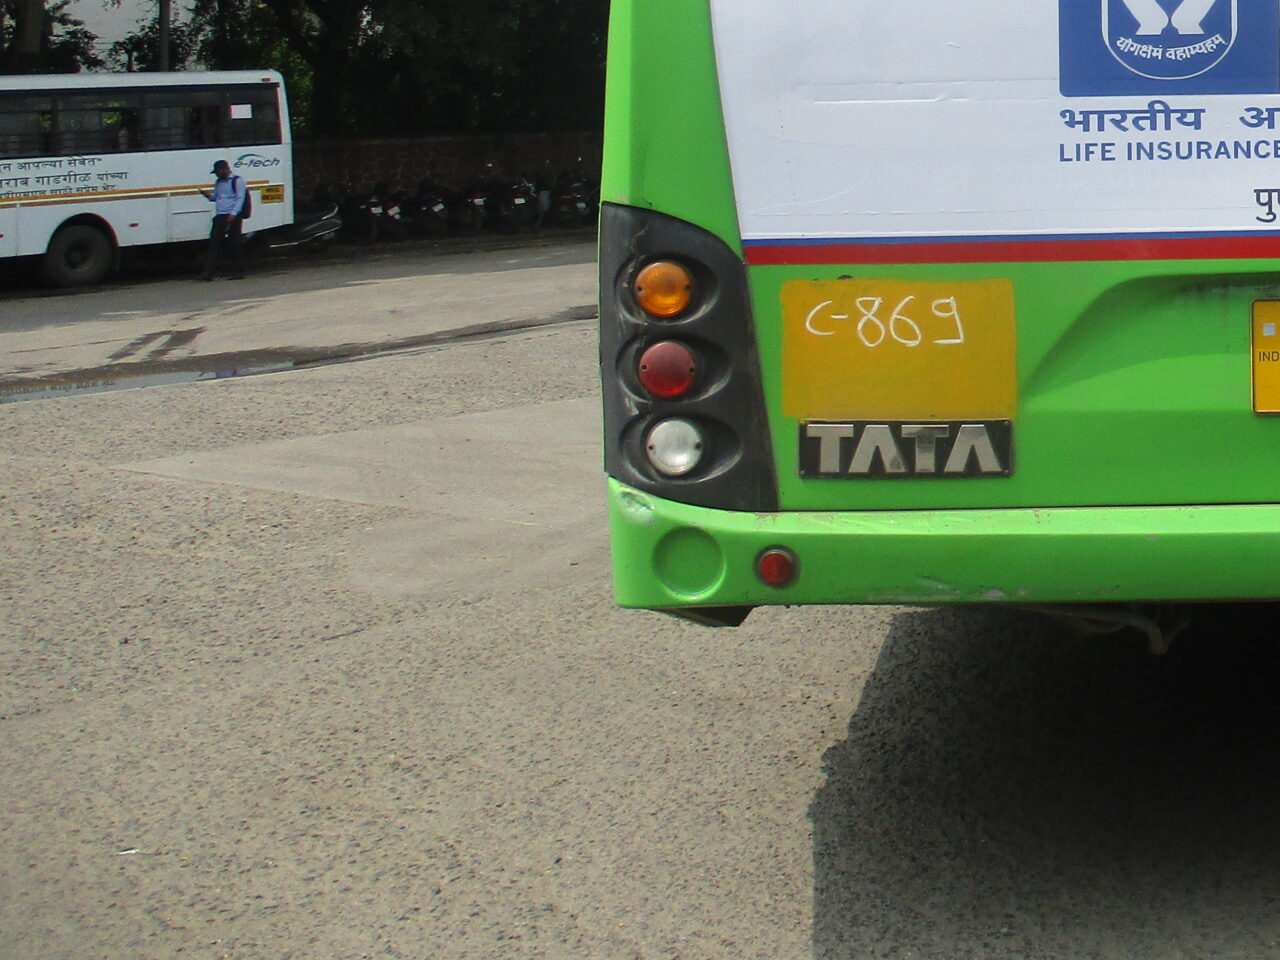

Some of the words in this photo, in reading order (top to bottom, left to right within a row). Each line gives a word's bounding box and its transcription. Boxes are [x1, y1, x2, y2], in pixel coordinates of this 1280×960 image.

[1059, 99, 1205, 133] भारतीय
[1058, 142, 1116, 162] LIFE
[1258, 351, 1280, 362] IND
[806, 424, 1002, 473] TATA
